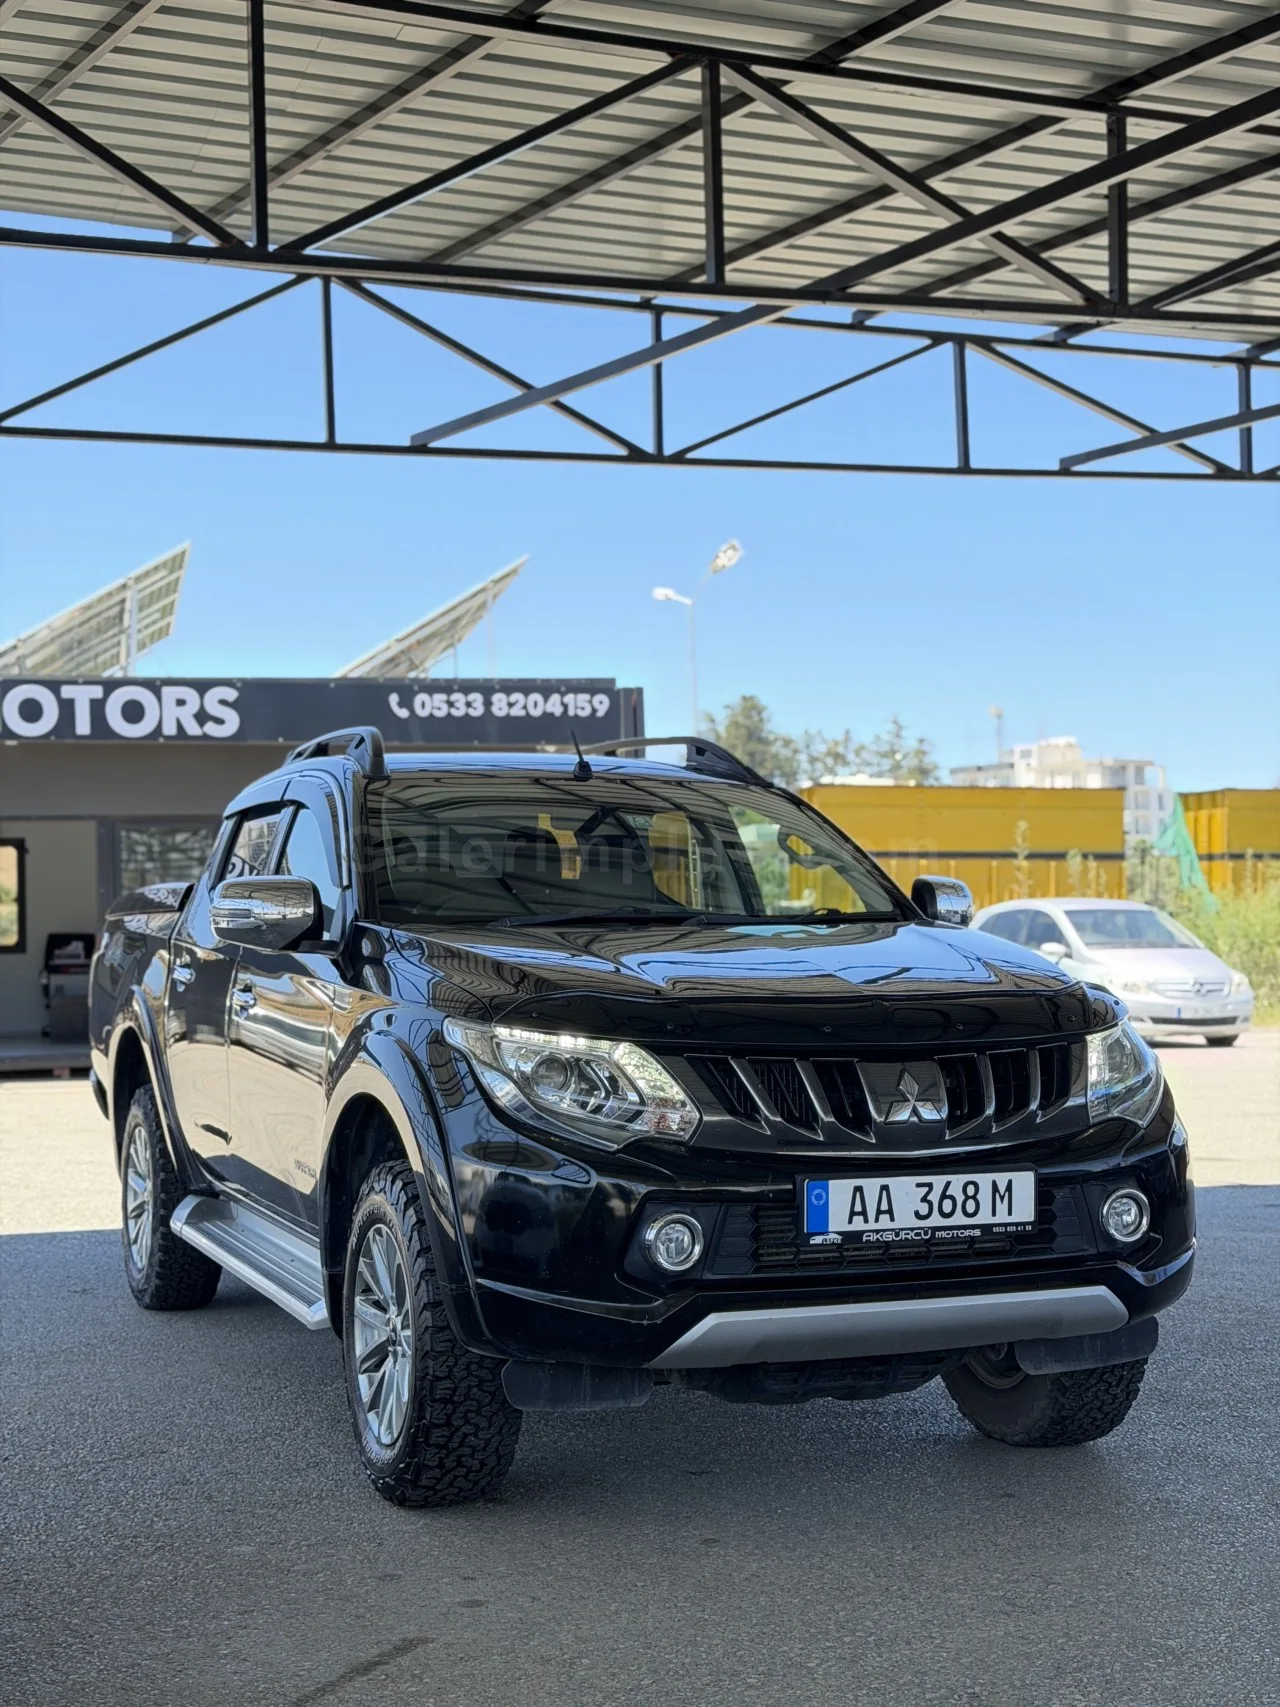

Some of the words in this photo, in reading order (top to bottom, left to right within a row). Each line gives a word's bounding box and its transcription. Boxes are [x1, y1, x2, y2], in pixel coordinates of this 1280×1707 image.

[0, 683, 240, 738] OTORS
[413, 692, 485, 718] 0533
[490, 692, 610, 718] 8204159
[847, 1183, 896, 1225] AA
[913, 1180, 981, 1221] 368
[991, 1178, 1013, 1218] M
[862, 1228, 932, 1243] AKGÜRCÜ
